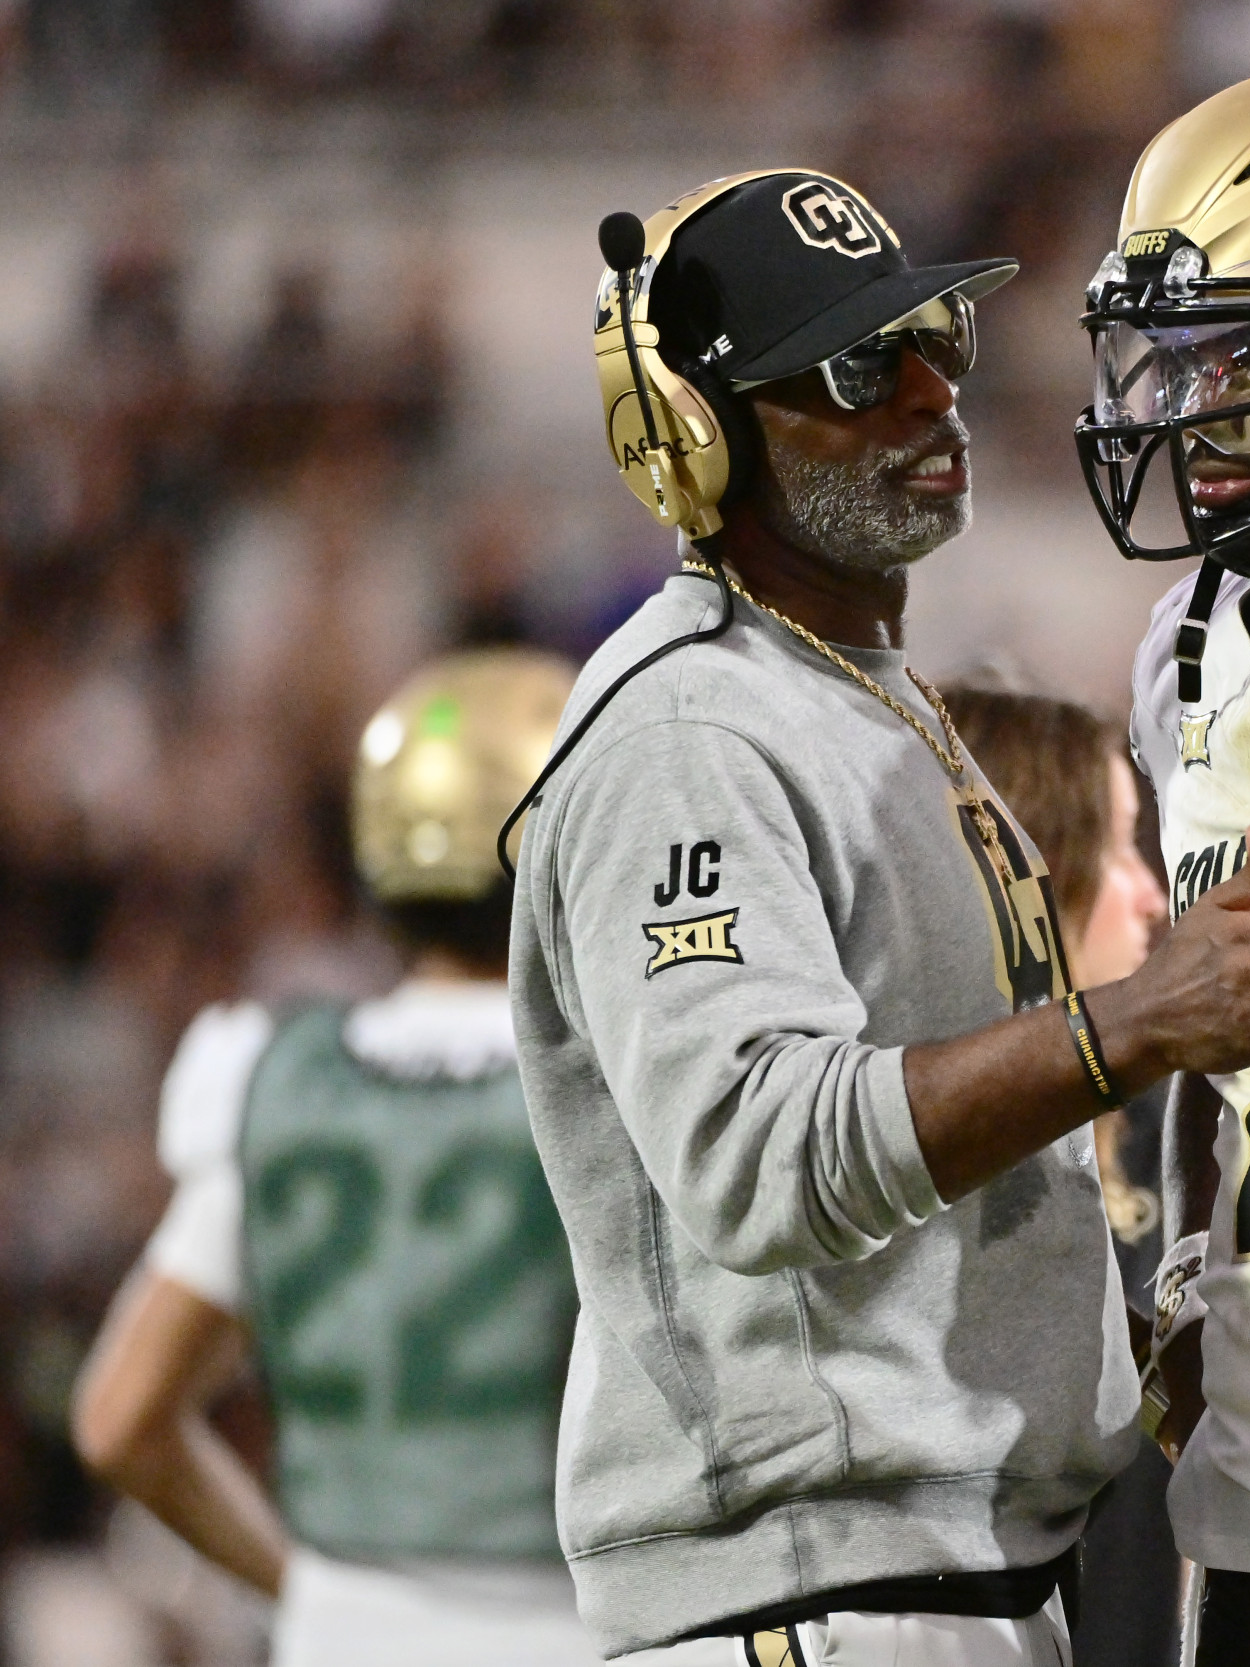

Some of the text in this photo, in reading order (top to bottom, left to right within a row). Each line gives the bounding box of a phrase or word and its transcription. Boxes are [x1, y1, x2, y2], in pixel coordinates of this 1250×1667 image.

[781, 181, 882, 259] CU
[1123, 231, 1170, 258] BUFFS
[623, 437, 690, 471] Afac
[653, 840, 722, 908] JC
[255, 1128, 572, 1426] 22
